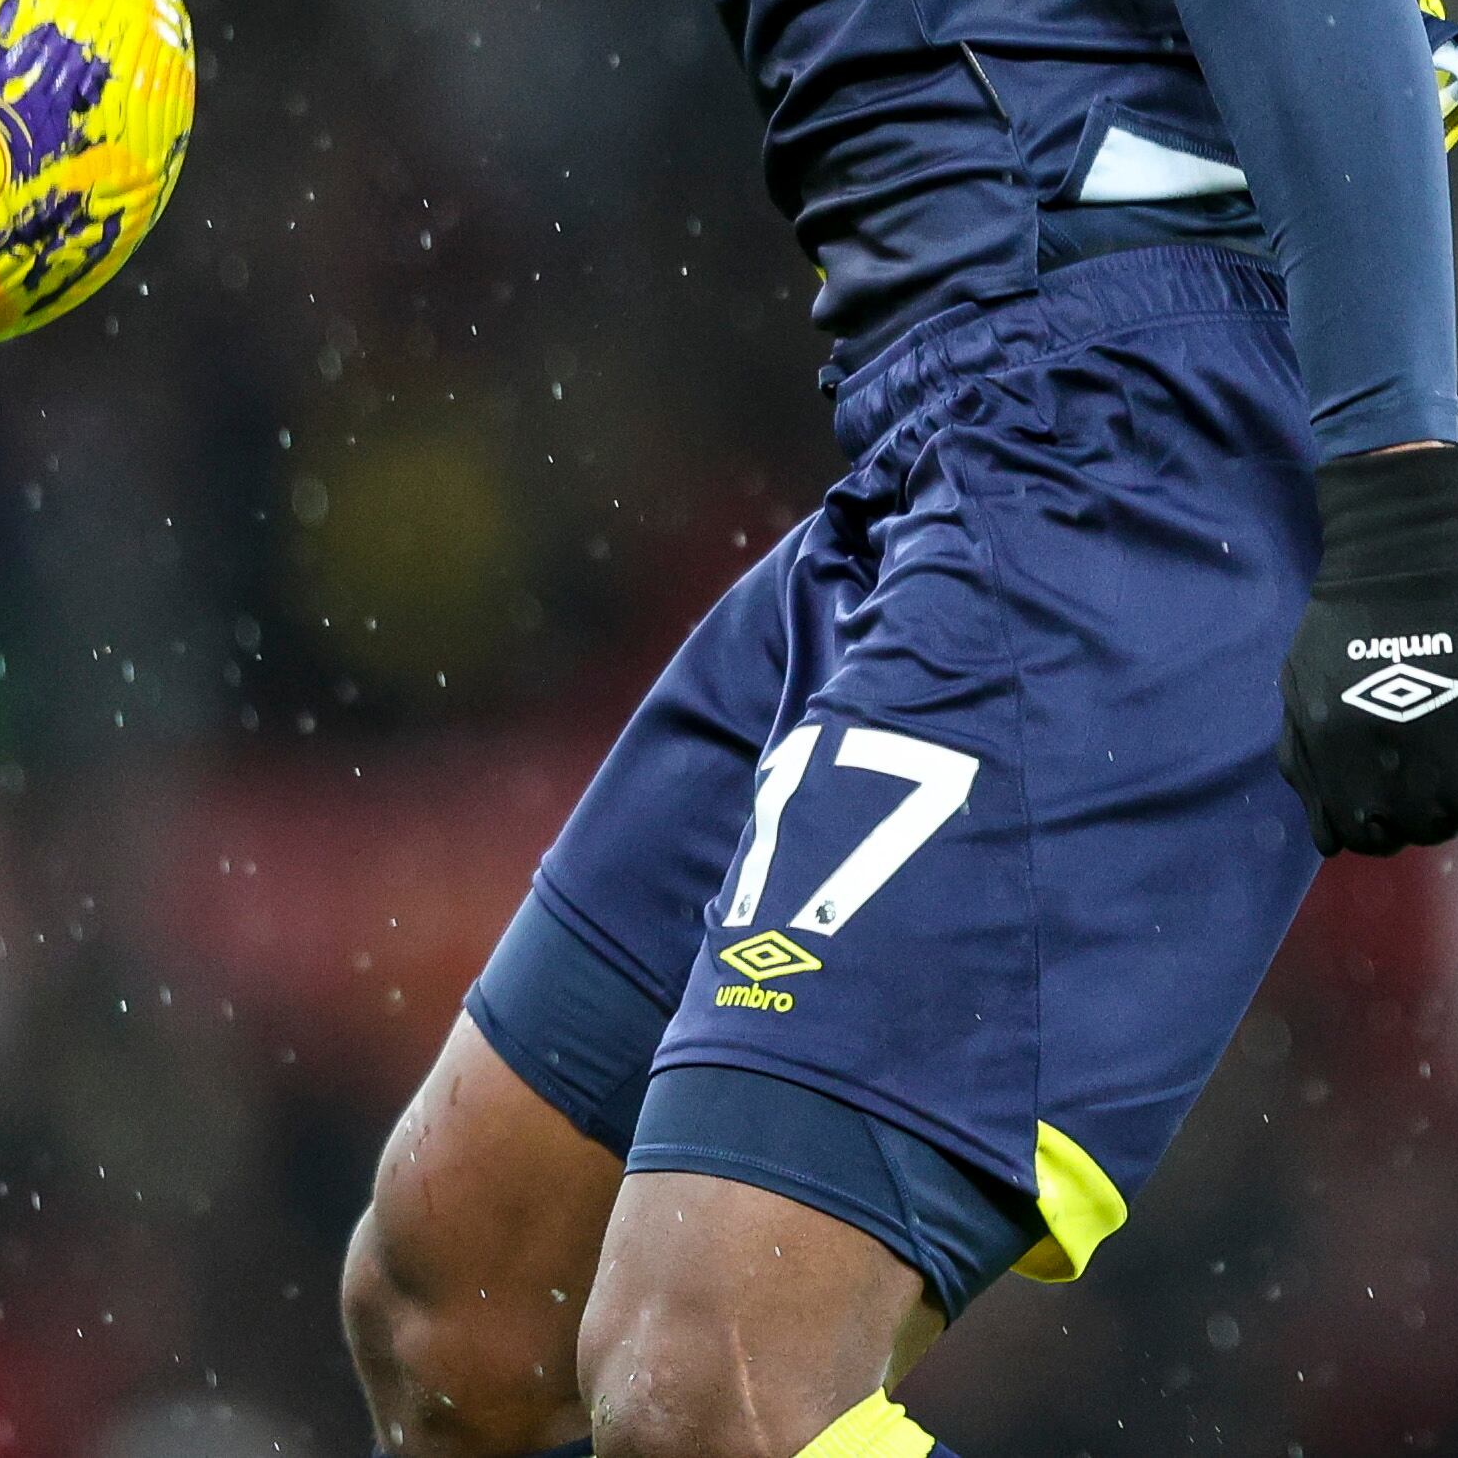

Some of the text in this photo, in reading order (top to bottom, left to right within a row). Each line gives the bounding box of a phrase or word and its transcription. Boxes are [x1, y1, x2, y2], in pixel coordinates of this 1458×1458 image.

[1346, 631, 1454, 664] umbro
[721, 724, 980, 938] 17
[715, 982, 795, 1013] umbro
